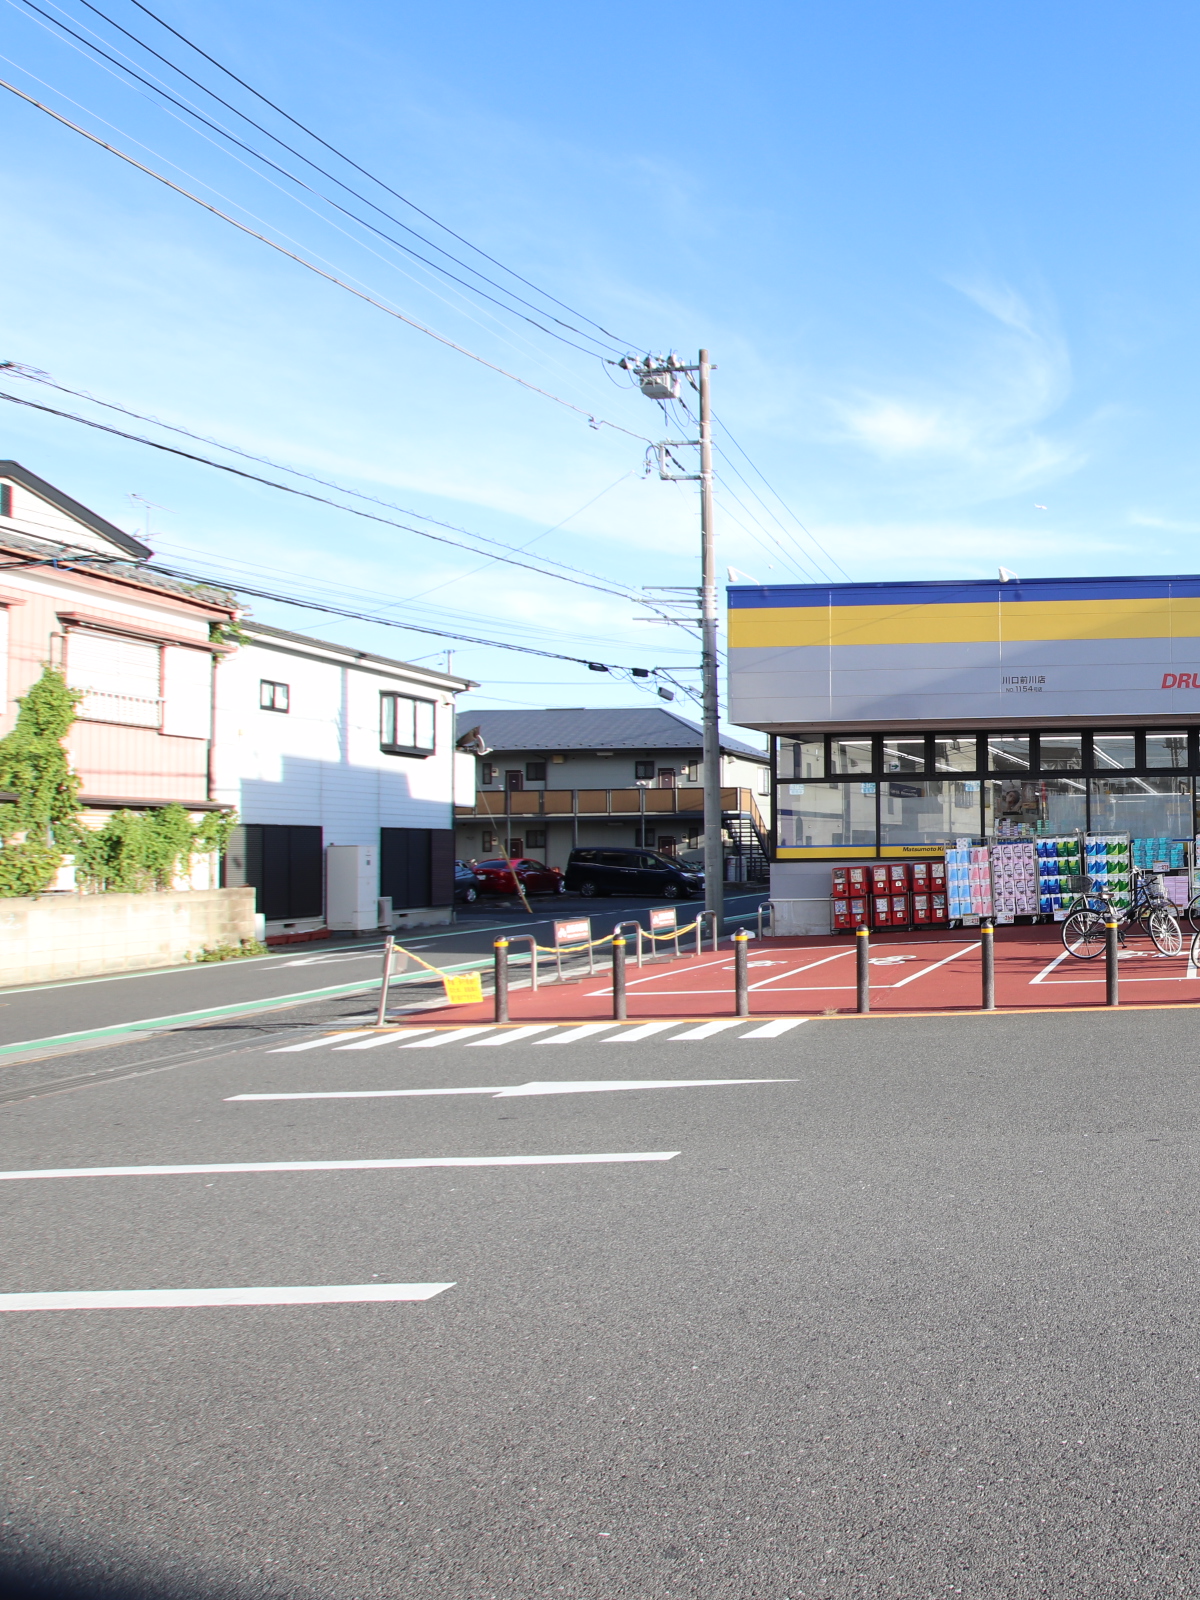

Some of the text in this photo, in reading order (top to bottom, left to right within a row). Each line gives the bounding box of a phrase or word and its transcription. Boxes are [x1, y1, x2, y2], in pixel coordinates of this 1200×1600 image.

[1002, 675, 1046, 684] 川口前川店
